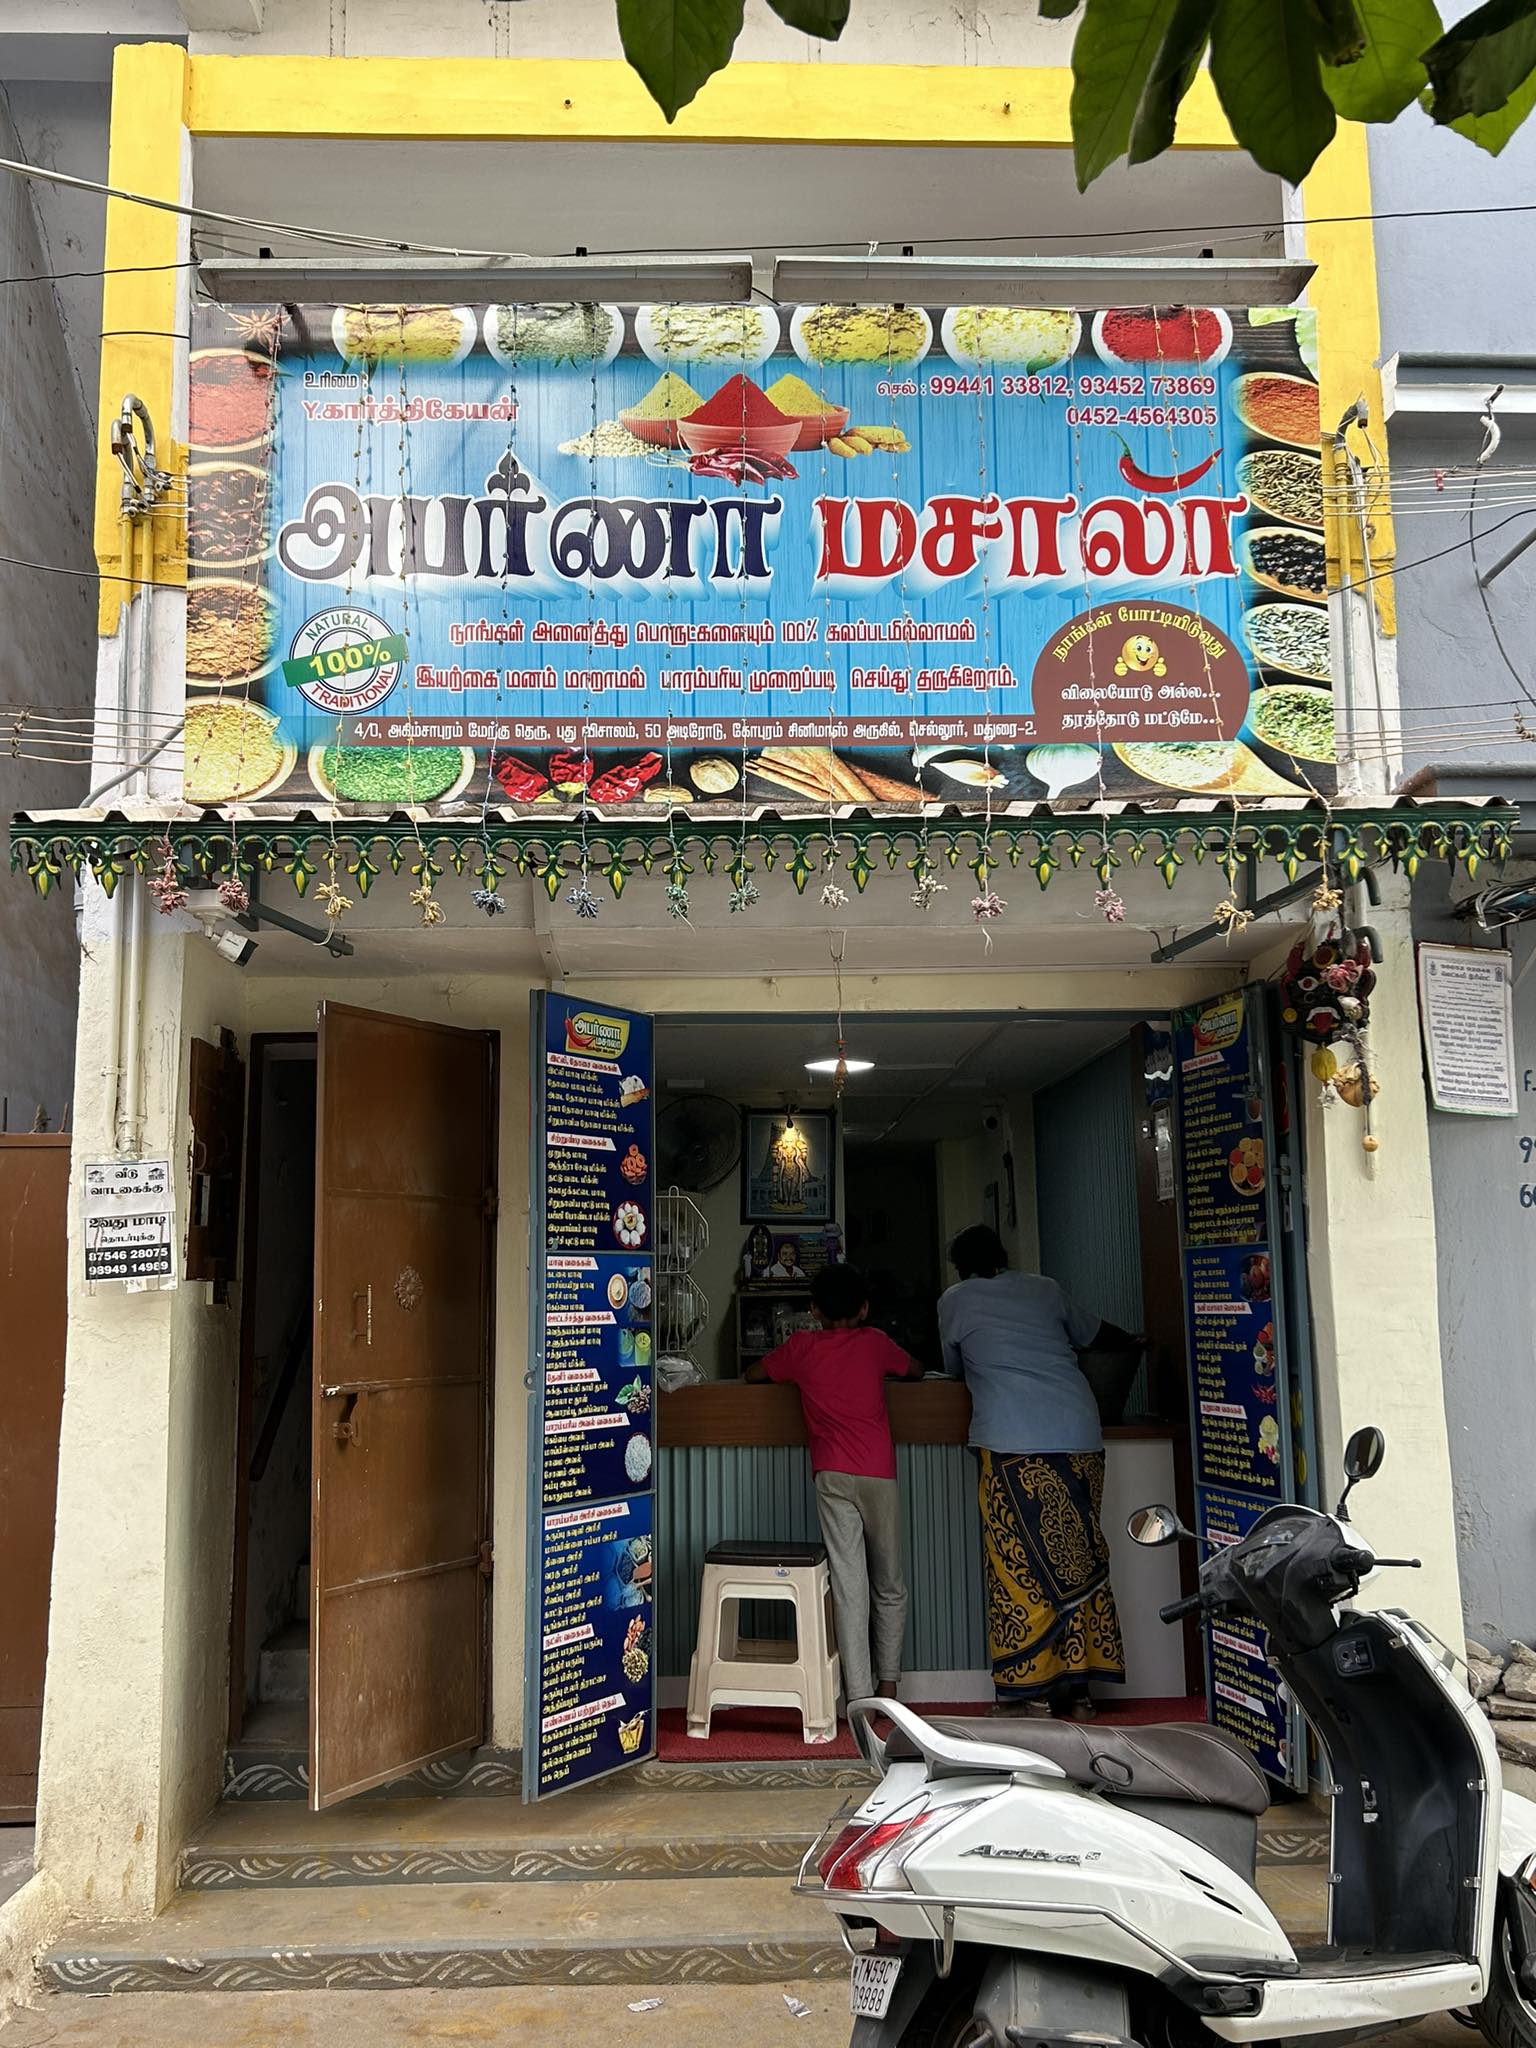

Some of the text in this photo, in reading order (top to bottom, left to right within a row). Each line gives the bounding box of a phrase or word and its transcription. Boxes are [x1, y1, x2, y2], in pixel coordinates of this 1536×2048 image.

[930, 377, 994, 395] 99441
[1001, 377, 1074, 398] 33812,
[1080, 377, 1145, 395] 93452
[1150, 377, 1216, 396] 73869
[1066, 407, 1217, 426] 0452-4564305
[281, 454, 781, 578] அபர்ணா
[305, 612, 369, 641] NATURAL
[451, 618, 975, 647] நாங்கள் அனைத்து பொருட்களையும் 100% கலப்படமில்லாமல்
[309, 641, 391, 677] 100%
[311, 667, 395, 708] TRADITIONAL
[416, 665, 498, 691] இயற்கை
[506, 666, 557, 689] மனம்
[565, 666, 645, 692] மாறாமல்
[661, 666, 742, 692] பாரம்பரிய
[750, 666, 836, 693] முறைப்படி
[852, 665, 909, 693] செய்து
[1061, 683, 1154, 701] விலையோடு
[1062, 710, 1139, 730] தரத்தோடு
[644, 722, 662, 739] 50
[575, 1019, 620, 1039] அபர்ணா
[114, 1167, 139, 1180] வீடு
[90, 1182, 164, 1195] வாடகைக்கு
[132, 1215, 167, 1227] மாடி
[88, 1247, 169, 1262] 87546 28075
[88, 1261, 169, 1276] 98949 14989
[857, 1958, 893, 1985] TN59C
